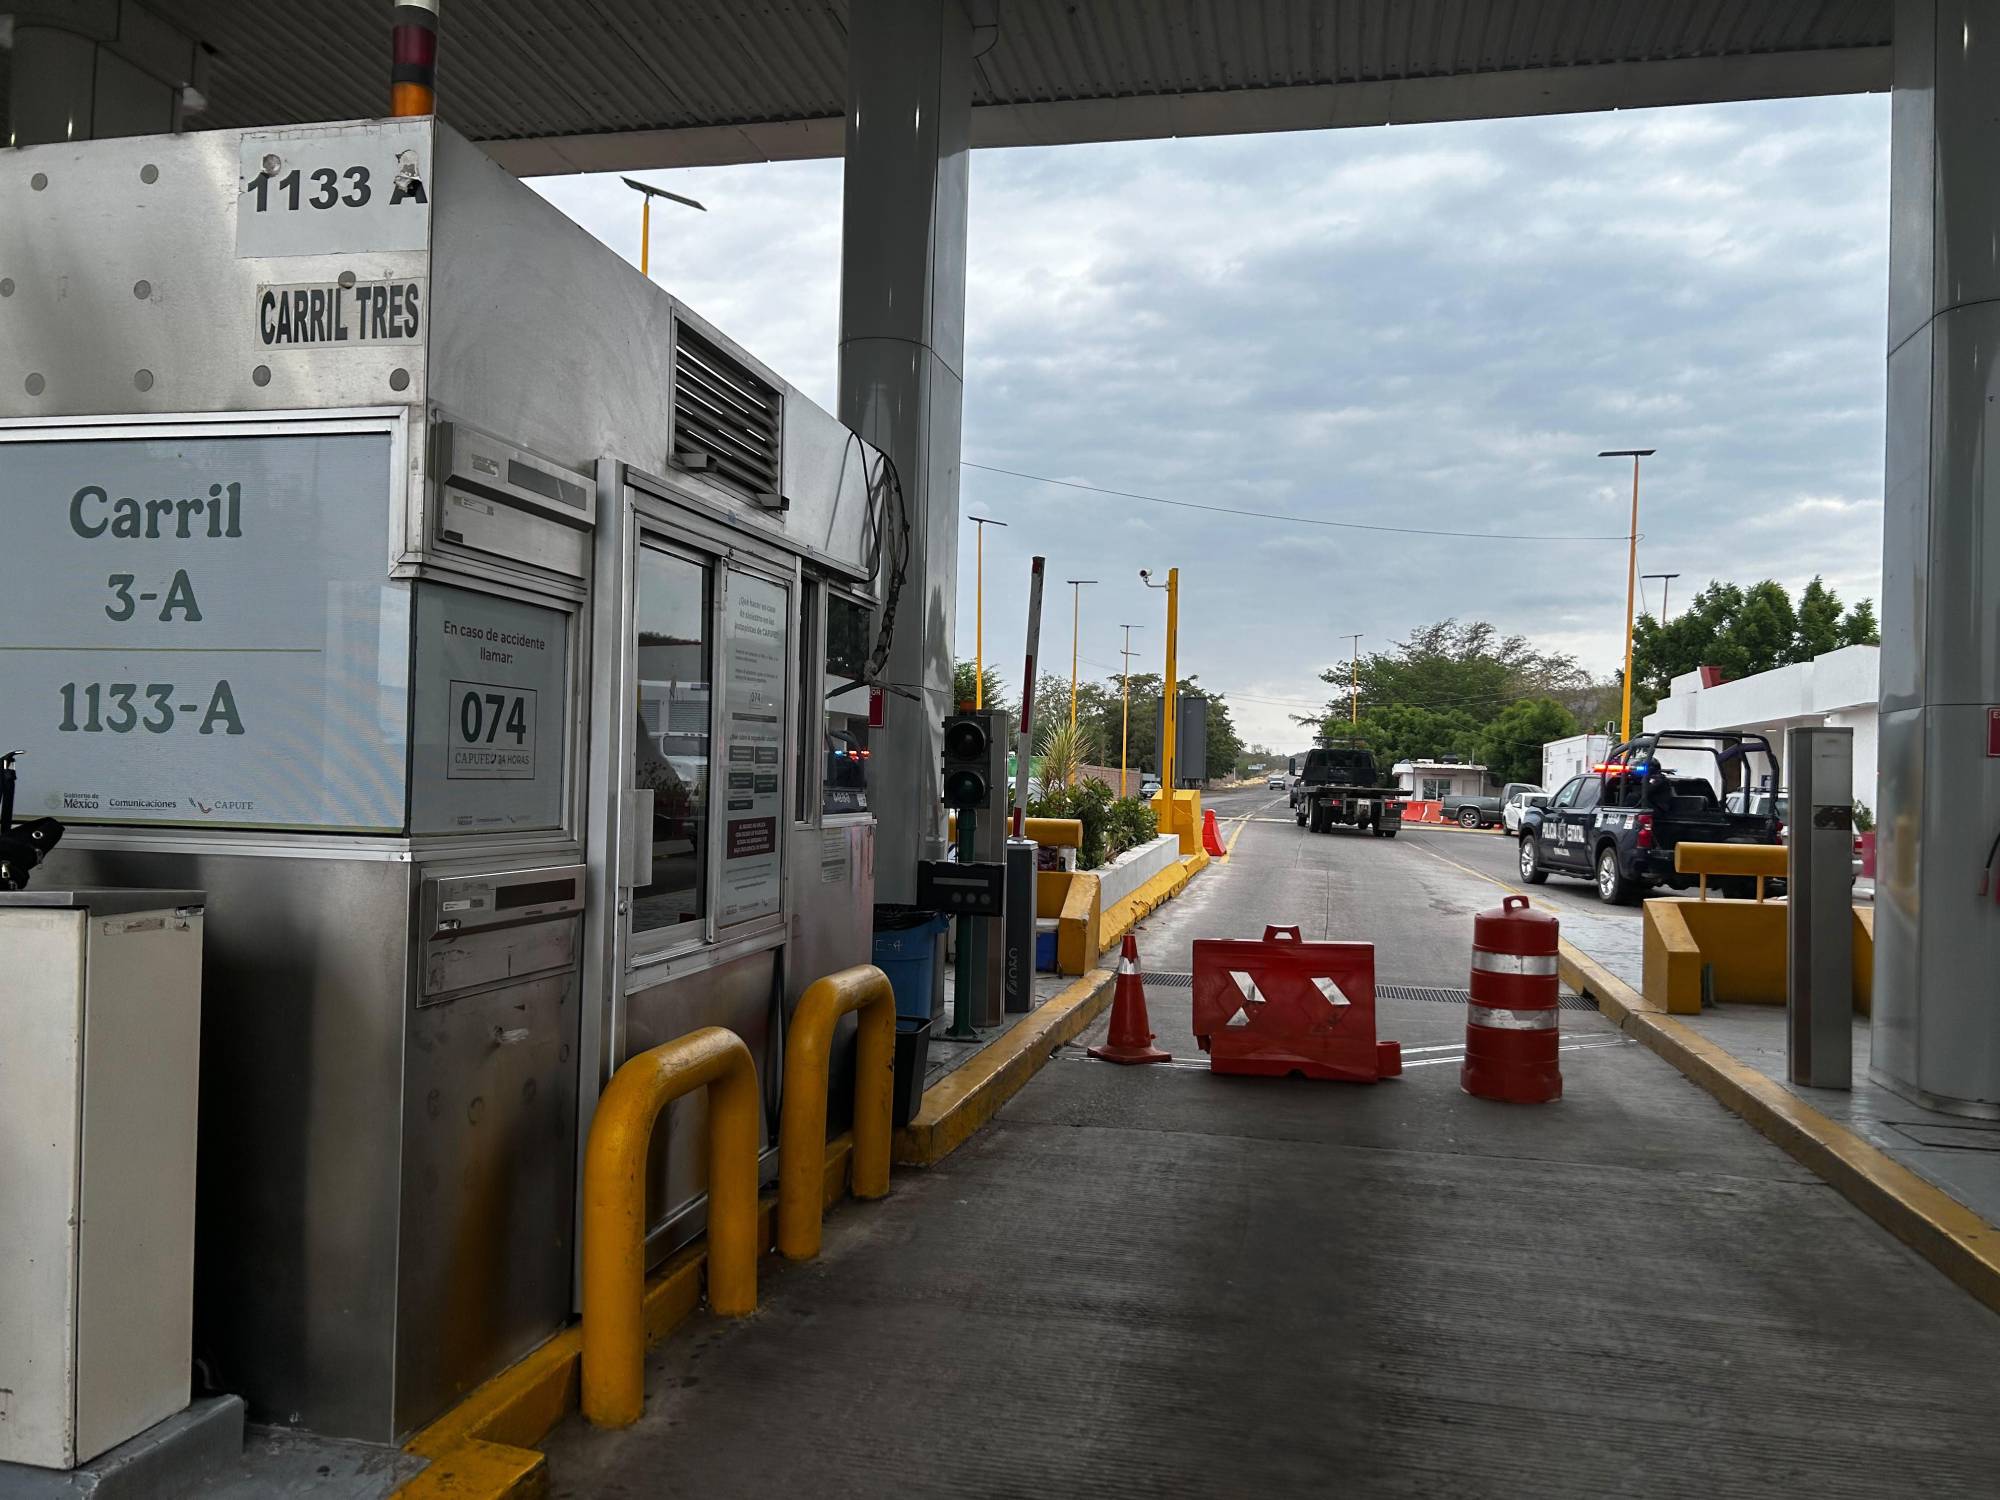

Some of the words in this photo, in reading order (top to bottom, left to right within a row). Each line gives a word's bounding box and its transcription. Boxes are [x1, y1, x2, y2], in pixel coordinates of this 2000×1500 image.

[247, 165, 372, 213] 1133
[260, 287, 349, 346] CARRIL
[356, 283, 419, 340] TRES
[69, 481, 243, 539] Carril
[104, 568, 203, 622] 3-A
[443, 620, 458, 635] En
[460, 625, 484, 640] caso
[486, 627, 498, 642] de
[500, 632, 545, 650] accidente
[480, 647, 513, 664] llamar:
[58, 679, 246, 735] 1133-A
[461, 691, 527, 745] 074
[455, 752, 490, 765] CAPUFE
[507, 754, 530, 765] HORAS
[63, 798, 99, 809] México
[109, 798, 177, 808] Comunicaciones
